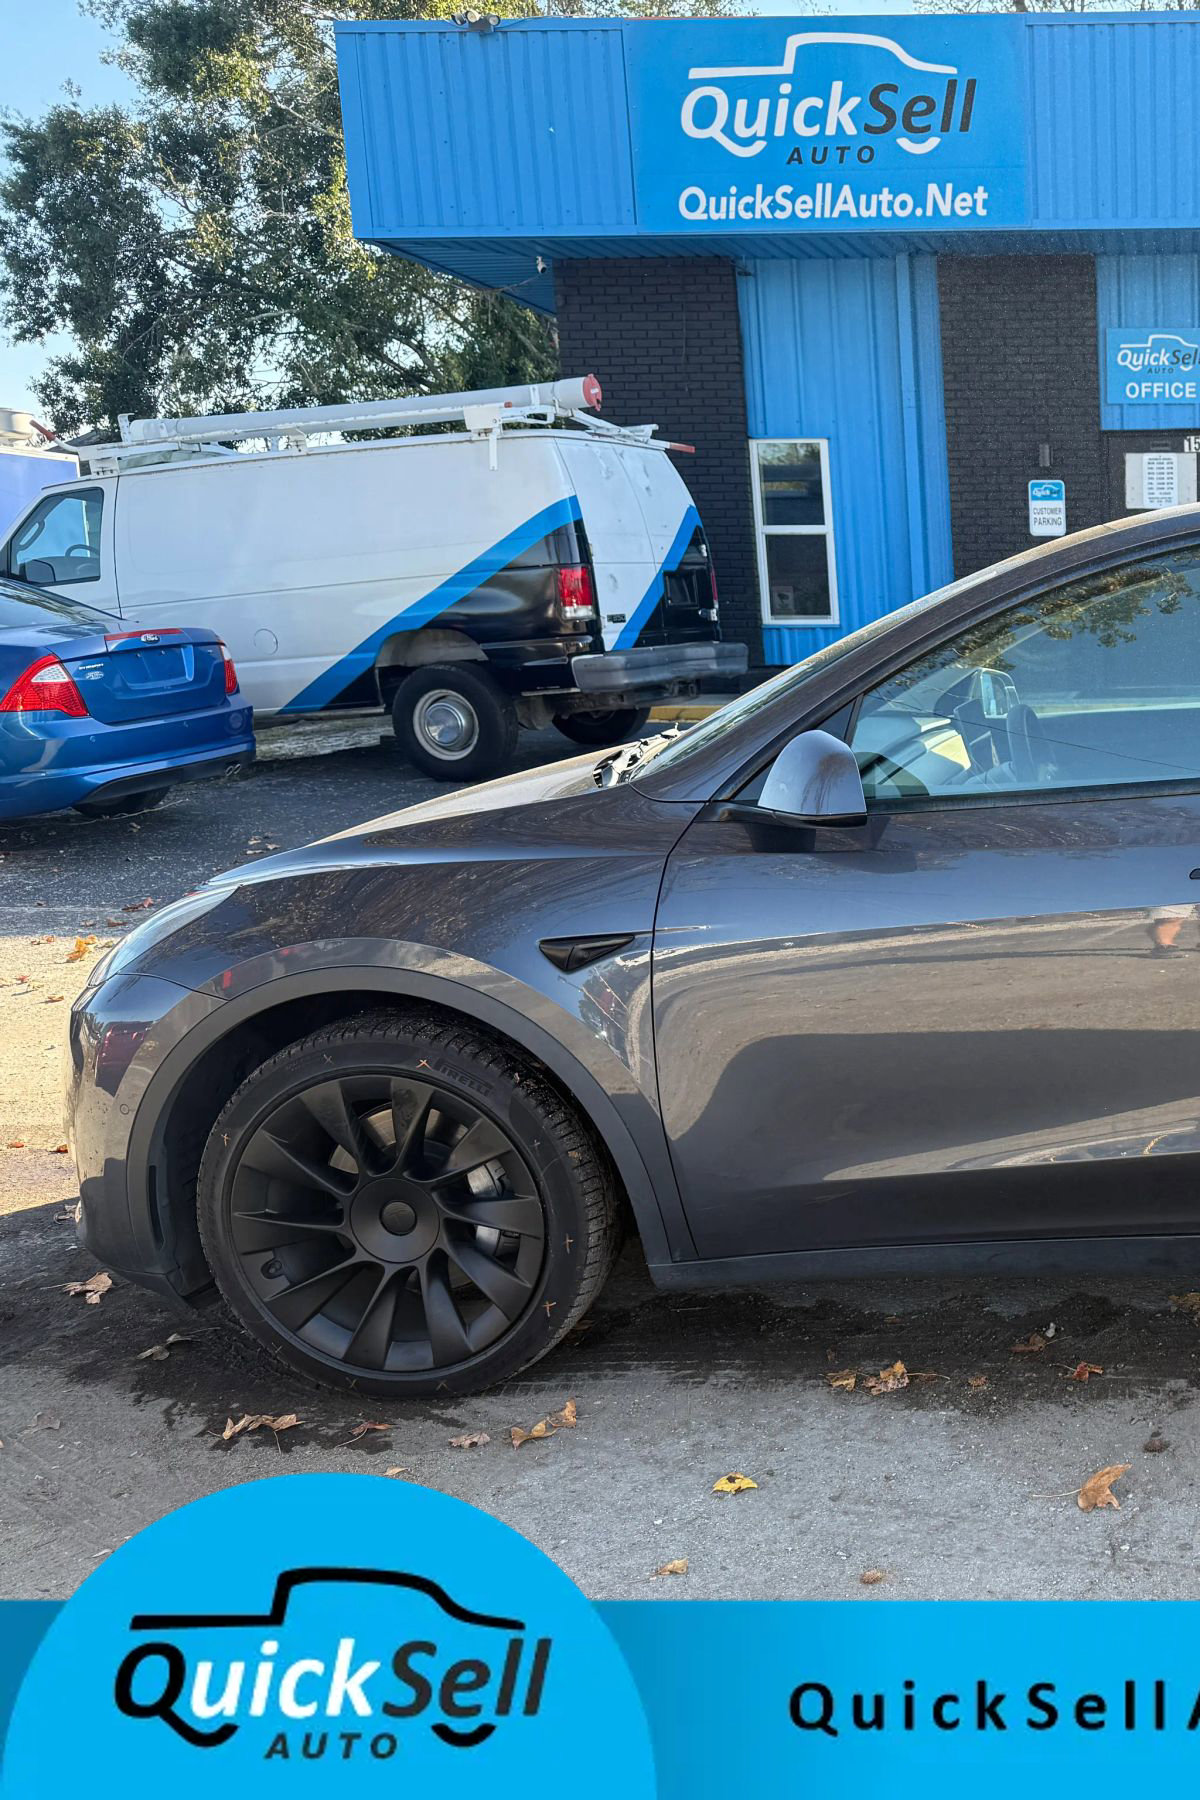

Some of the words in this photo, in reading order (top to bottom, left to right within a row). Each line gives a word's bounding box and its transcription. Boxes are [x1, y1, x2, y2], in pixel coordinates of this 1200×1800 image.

[680, 78, 977, 158] QuickSell
[786, 144, 875, 165] AUTO
[678, 182, 988, 221] QuickSellAuto.Net
[1147, 367, 1175, 375] AUTO
[1125, 382, 1197, 399] OFFICE
[1032, 507, 1062, 516] CUSTOMER
[1033, 516, 1063, 527] PARKING
[434, 1057, 494, 1097] PIRELLI
